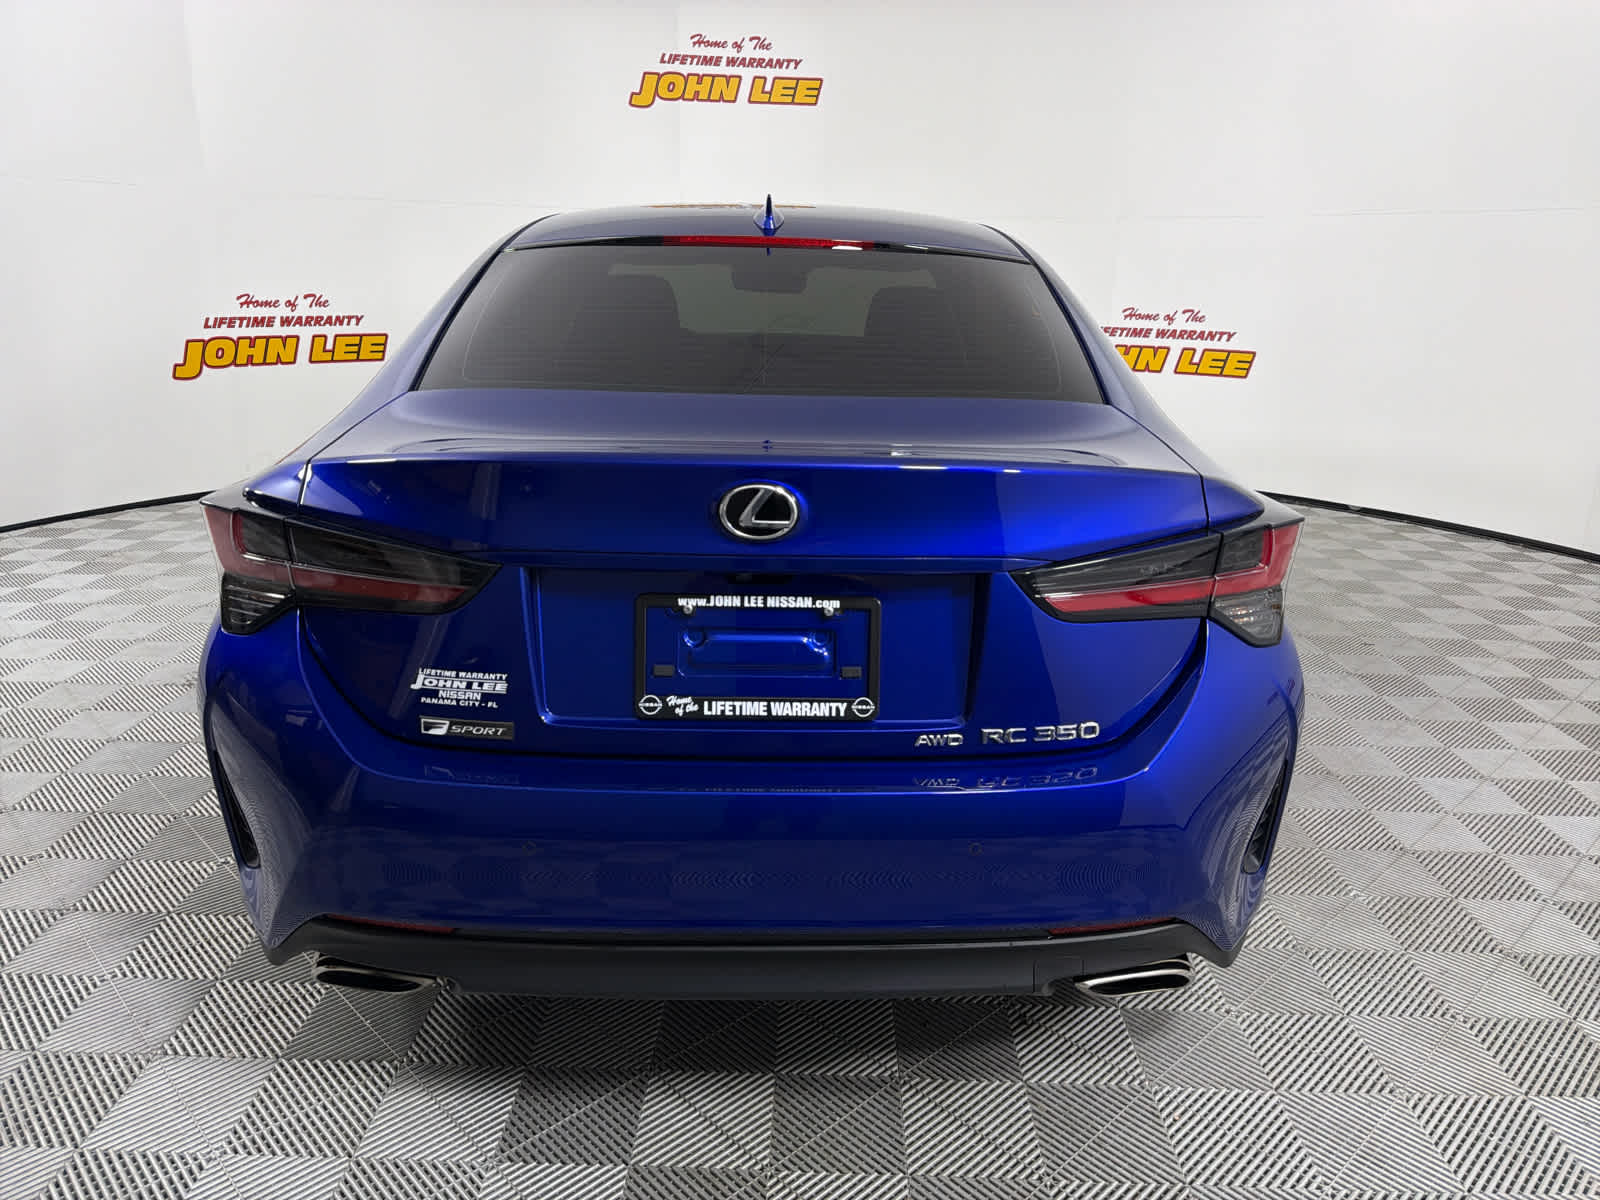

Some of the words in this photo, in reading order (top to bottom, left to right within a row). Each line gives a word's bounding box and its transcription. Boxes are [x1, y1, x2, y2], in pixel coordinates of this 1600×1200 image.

[690, 33, 728, 48] Home
[731, 37, 745, 54] of
[749, 36, 773, 51] The
[659, 53, 723, 67] LIFETIME
[725, 56, 803, 70] WARRANTY
[628, 71, 742, 108] JOHN
[748, 75, 824, 106] LEE
[236, 293, 280, 309] Home
[284, 295, 299, 312] of
[303, 293, 330, 308] The
[203, 316, 276, 329] LIFETIME
[279, 315, 364, 328] WARRANTY
[1122, 306, 1160, 322] Home
[1163, 310, 1178, 326] of
[1182, 308, 1206, 324] The
[1101, 326, 1154, 338] FETIME
[1155, 328, 1237, 342] WARRANTY
[172, 334, 300, 381] JOHN
[308, 333, 389, 363] LEE
[1115, 344, 1171, 374] HN
[1174, 347, 1256, 379] LEE
[743, 595, 764, 607] LEE
[410, 674, 468, 690] JOHN
[471, 682, 509, 692] LEE
[418, 668, 457, 678] LIFETIME
[459, 671, 508, 681] WARRANTY
[421, 697, 457, 706] PANAMA
[459, 699, 480, 707] CITY
[487, 701, 499, 709] FL
[438, 690, 482, 701] NISSAN
[703, 701, 768, 716] LIFETIME
[770, 702, 847, 717] WARRANTY
[449, 725, 508, 736] SPORT
[914, 733, 964, 747] AWD
[981, 727, 1027, 744] RC
[1033, 721, 1100, 742] 350
